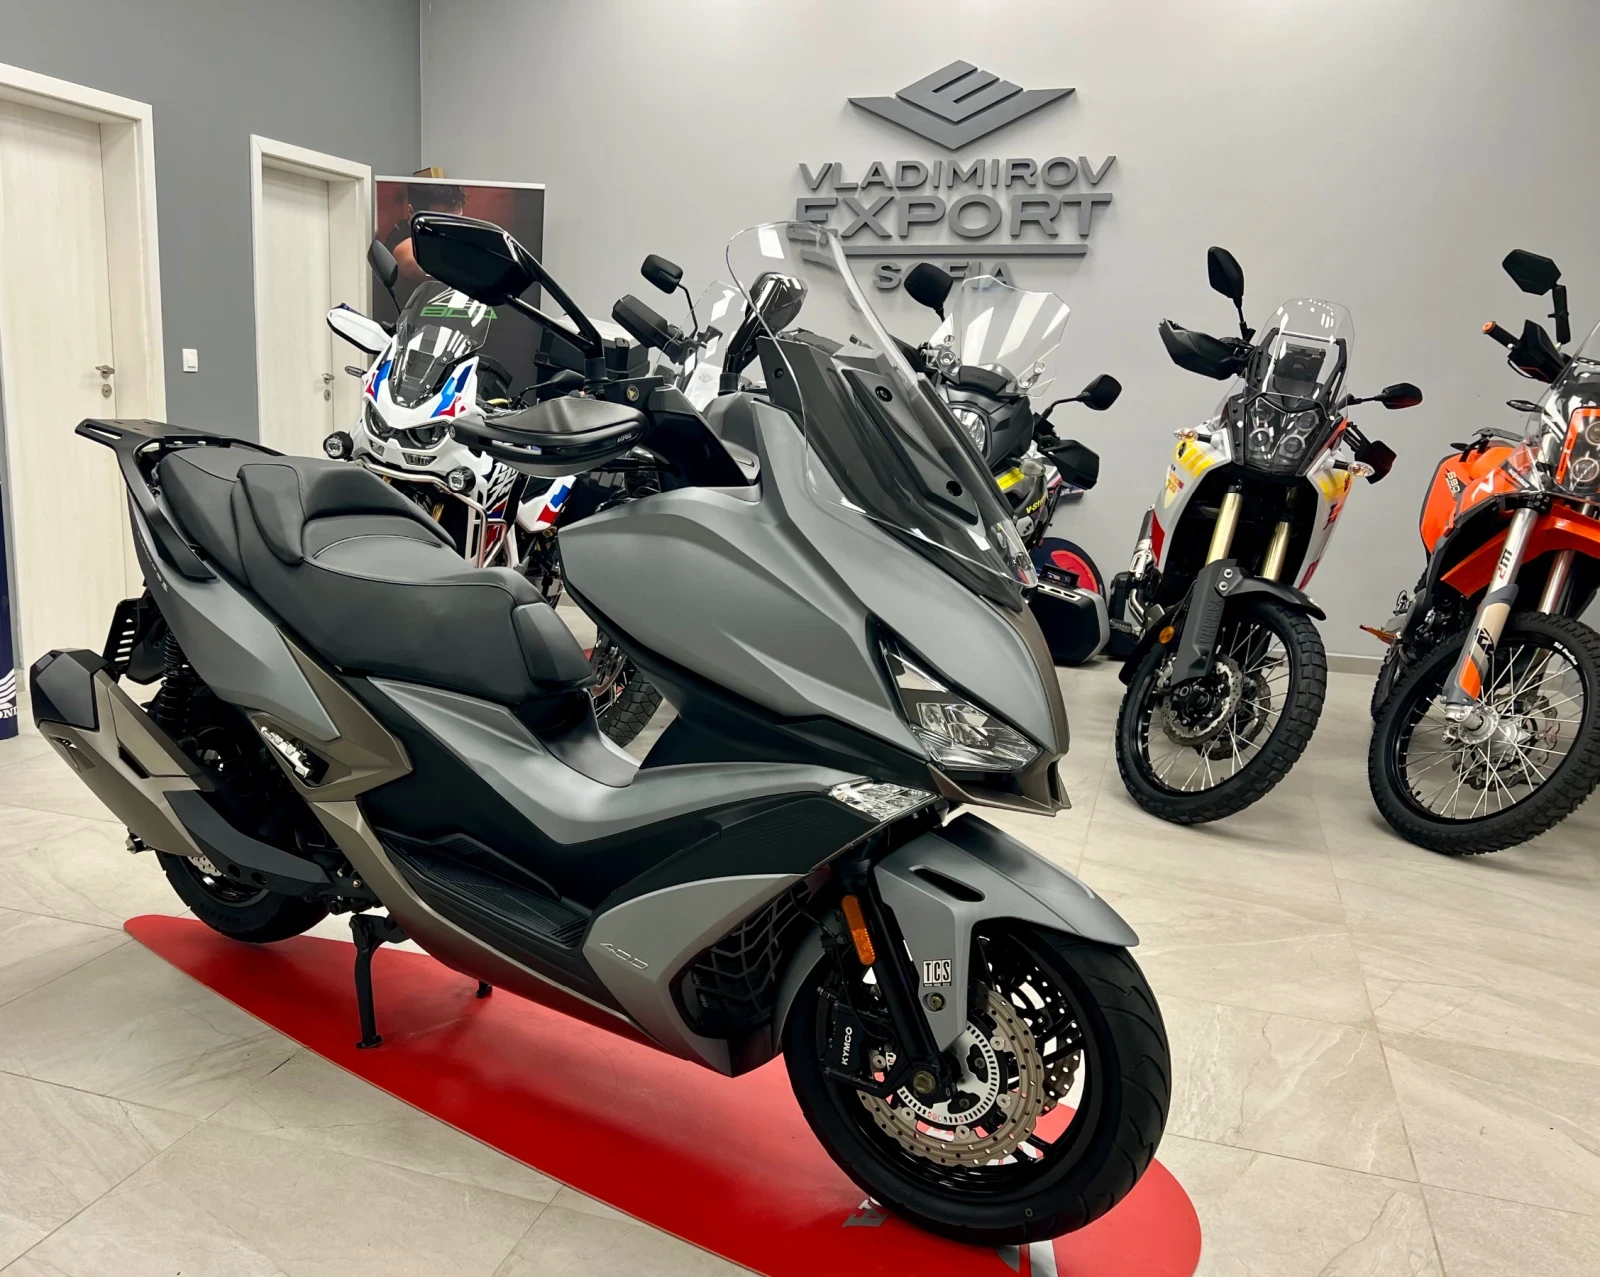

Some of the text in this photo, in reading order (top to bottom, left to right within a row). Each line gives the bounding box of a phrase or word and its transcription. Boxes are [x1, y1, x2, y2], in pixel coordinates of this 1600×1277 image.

[798, 155, 1117, 190] VLADIMIROV
[794, 193, 1113, 238] EXPORT
[872, 261, 1015, 291] SFIA
[600, 942, 649, 970] 400
[924, 960, 951, 982] TCS
[841, 1026, 853, 1066] KYMCO
